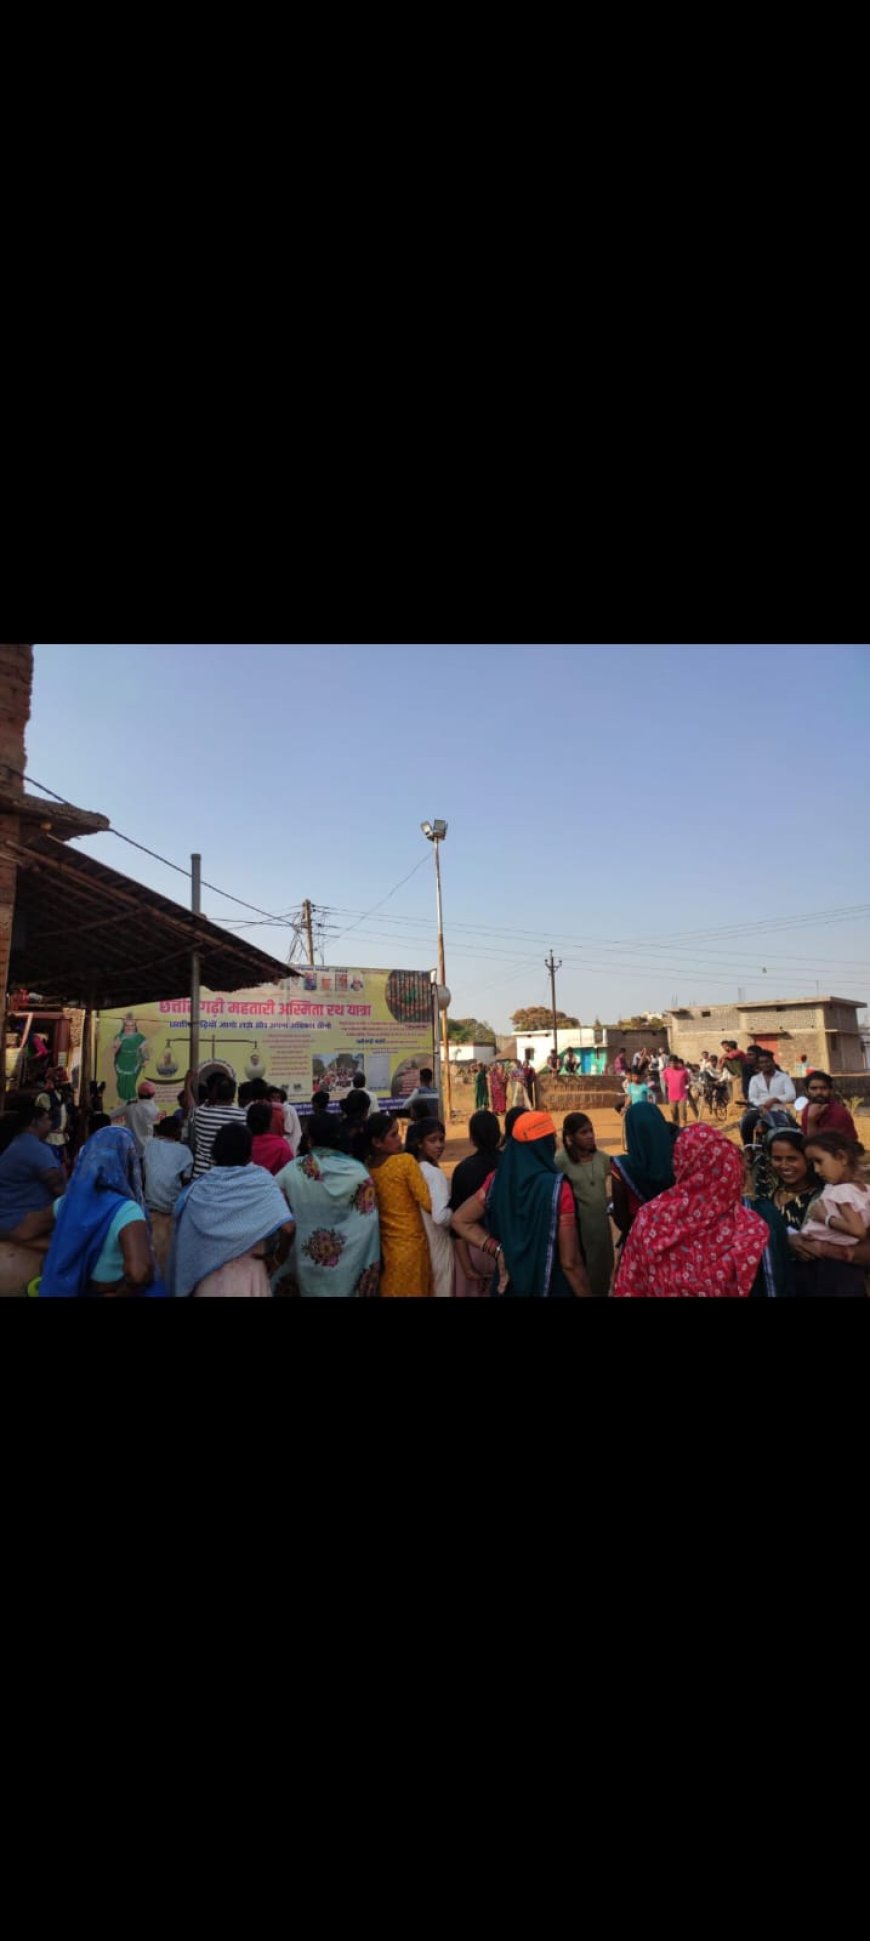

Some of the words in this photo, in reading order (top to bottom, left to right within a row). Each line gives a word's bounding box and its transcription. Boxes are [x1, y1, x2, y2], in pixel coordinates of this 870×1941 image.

[159, 997, 224, 1018] छत्तीगढ़ी
[228, 999, 274, 1016] महतारी
[279, 999, 324, 1017] अस्मिता
[327, 1003, 344, 1017] रथ
[347, 1004, 371, 1018] यात्रा
